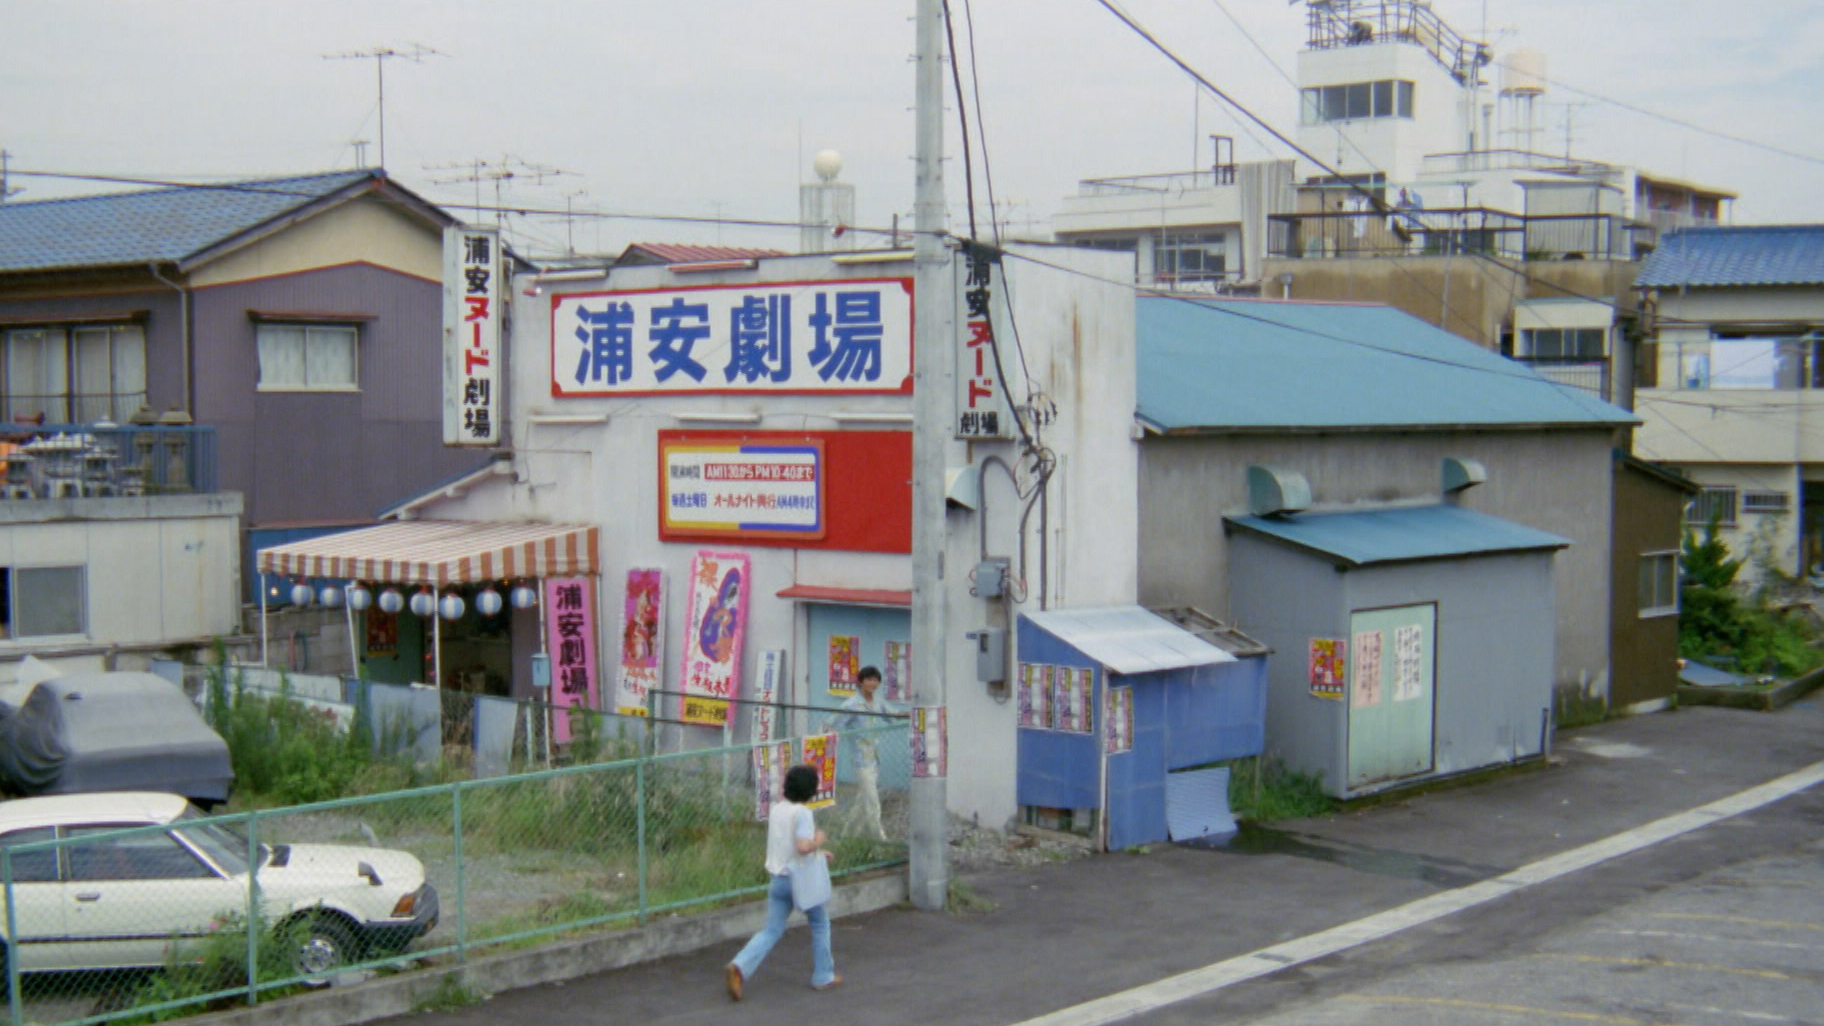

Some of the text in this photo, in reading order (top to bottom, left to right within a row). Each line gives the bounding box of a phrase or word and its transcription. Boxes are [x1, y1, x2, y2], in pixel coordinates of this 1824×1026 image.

[463, 235, 491, 438] 浦安ヌード劇場
[574, 290, 884, 386] 浦安劇場
[556, 583, 589, 694] 浦安劇場
